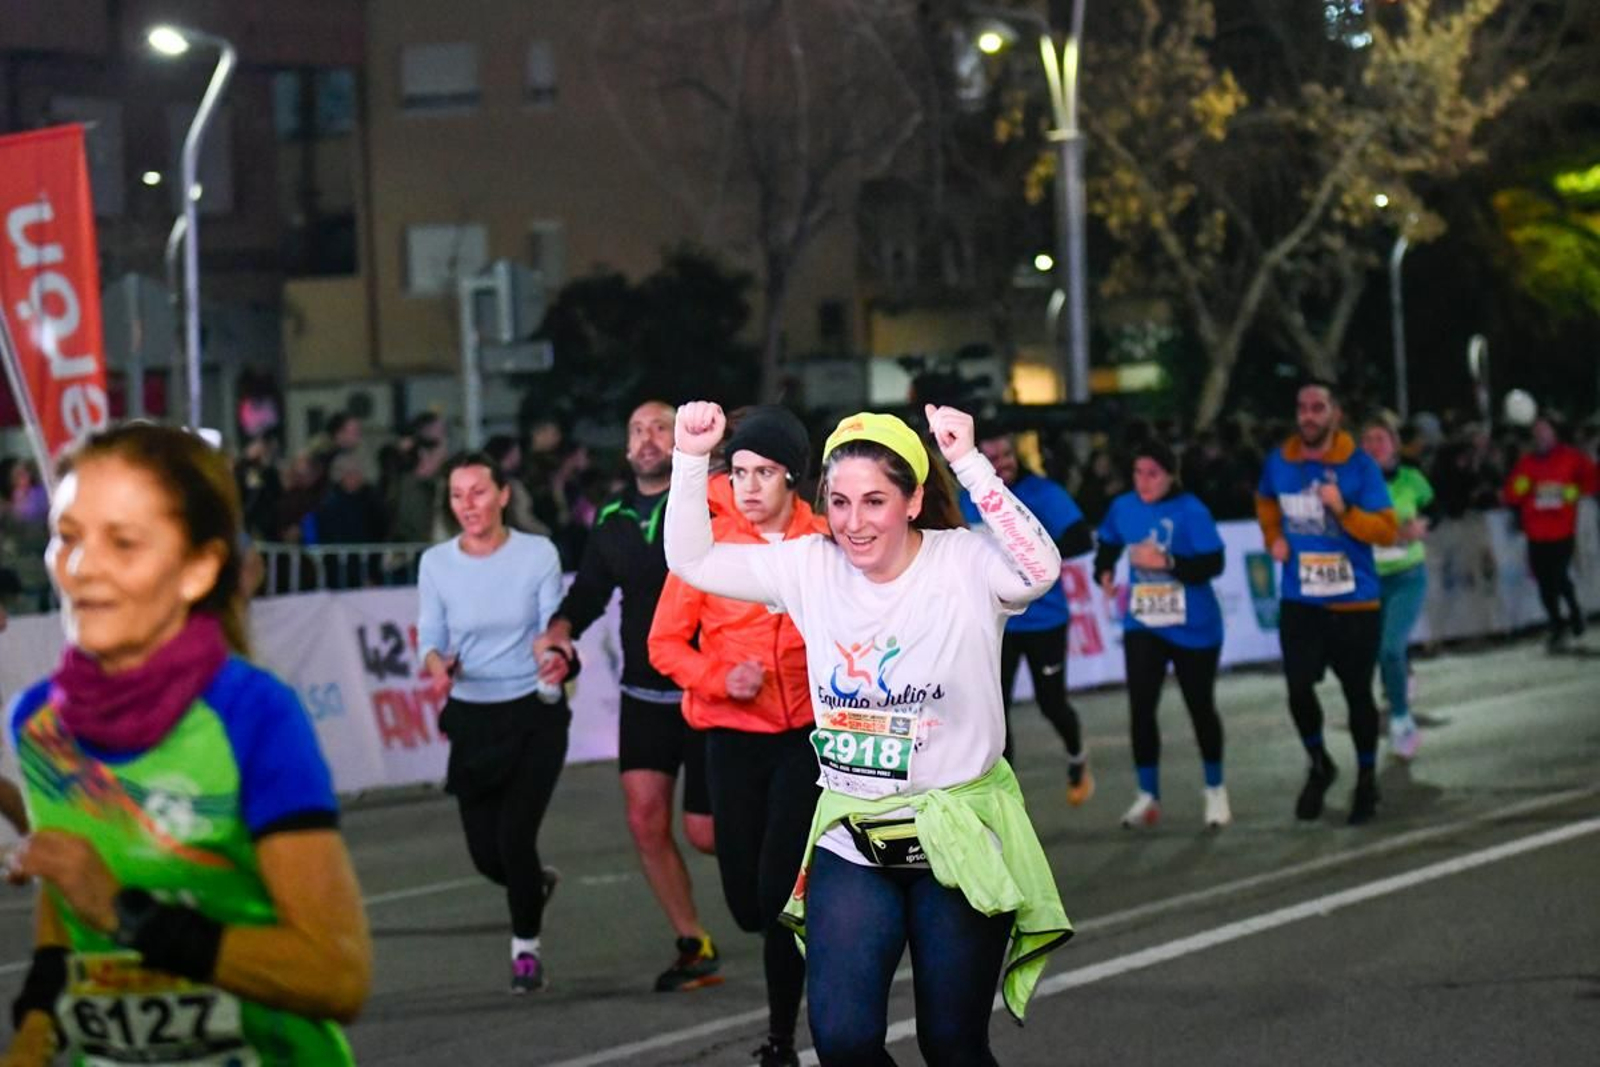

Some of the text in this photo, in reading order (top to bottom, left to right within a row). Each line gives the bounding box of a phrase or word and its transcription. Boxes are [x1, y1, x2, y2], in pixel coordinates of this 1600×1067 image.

[7, 200, 109, 448] erón
[818, 730, 903, 770] 2918
[72, 996, 219, 1047] 6127
